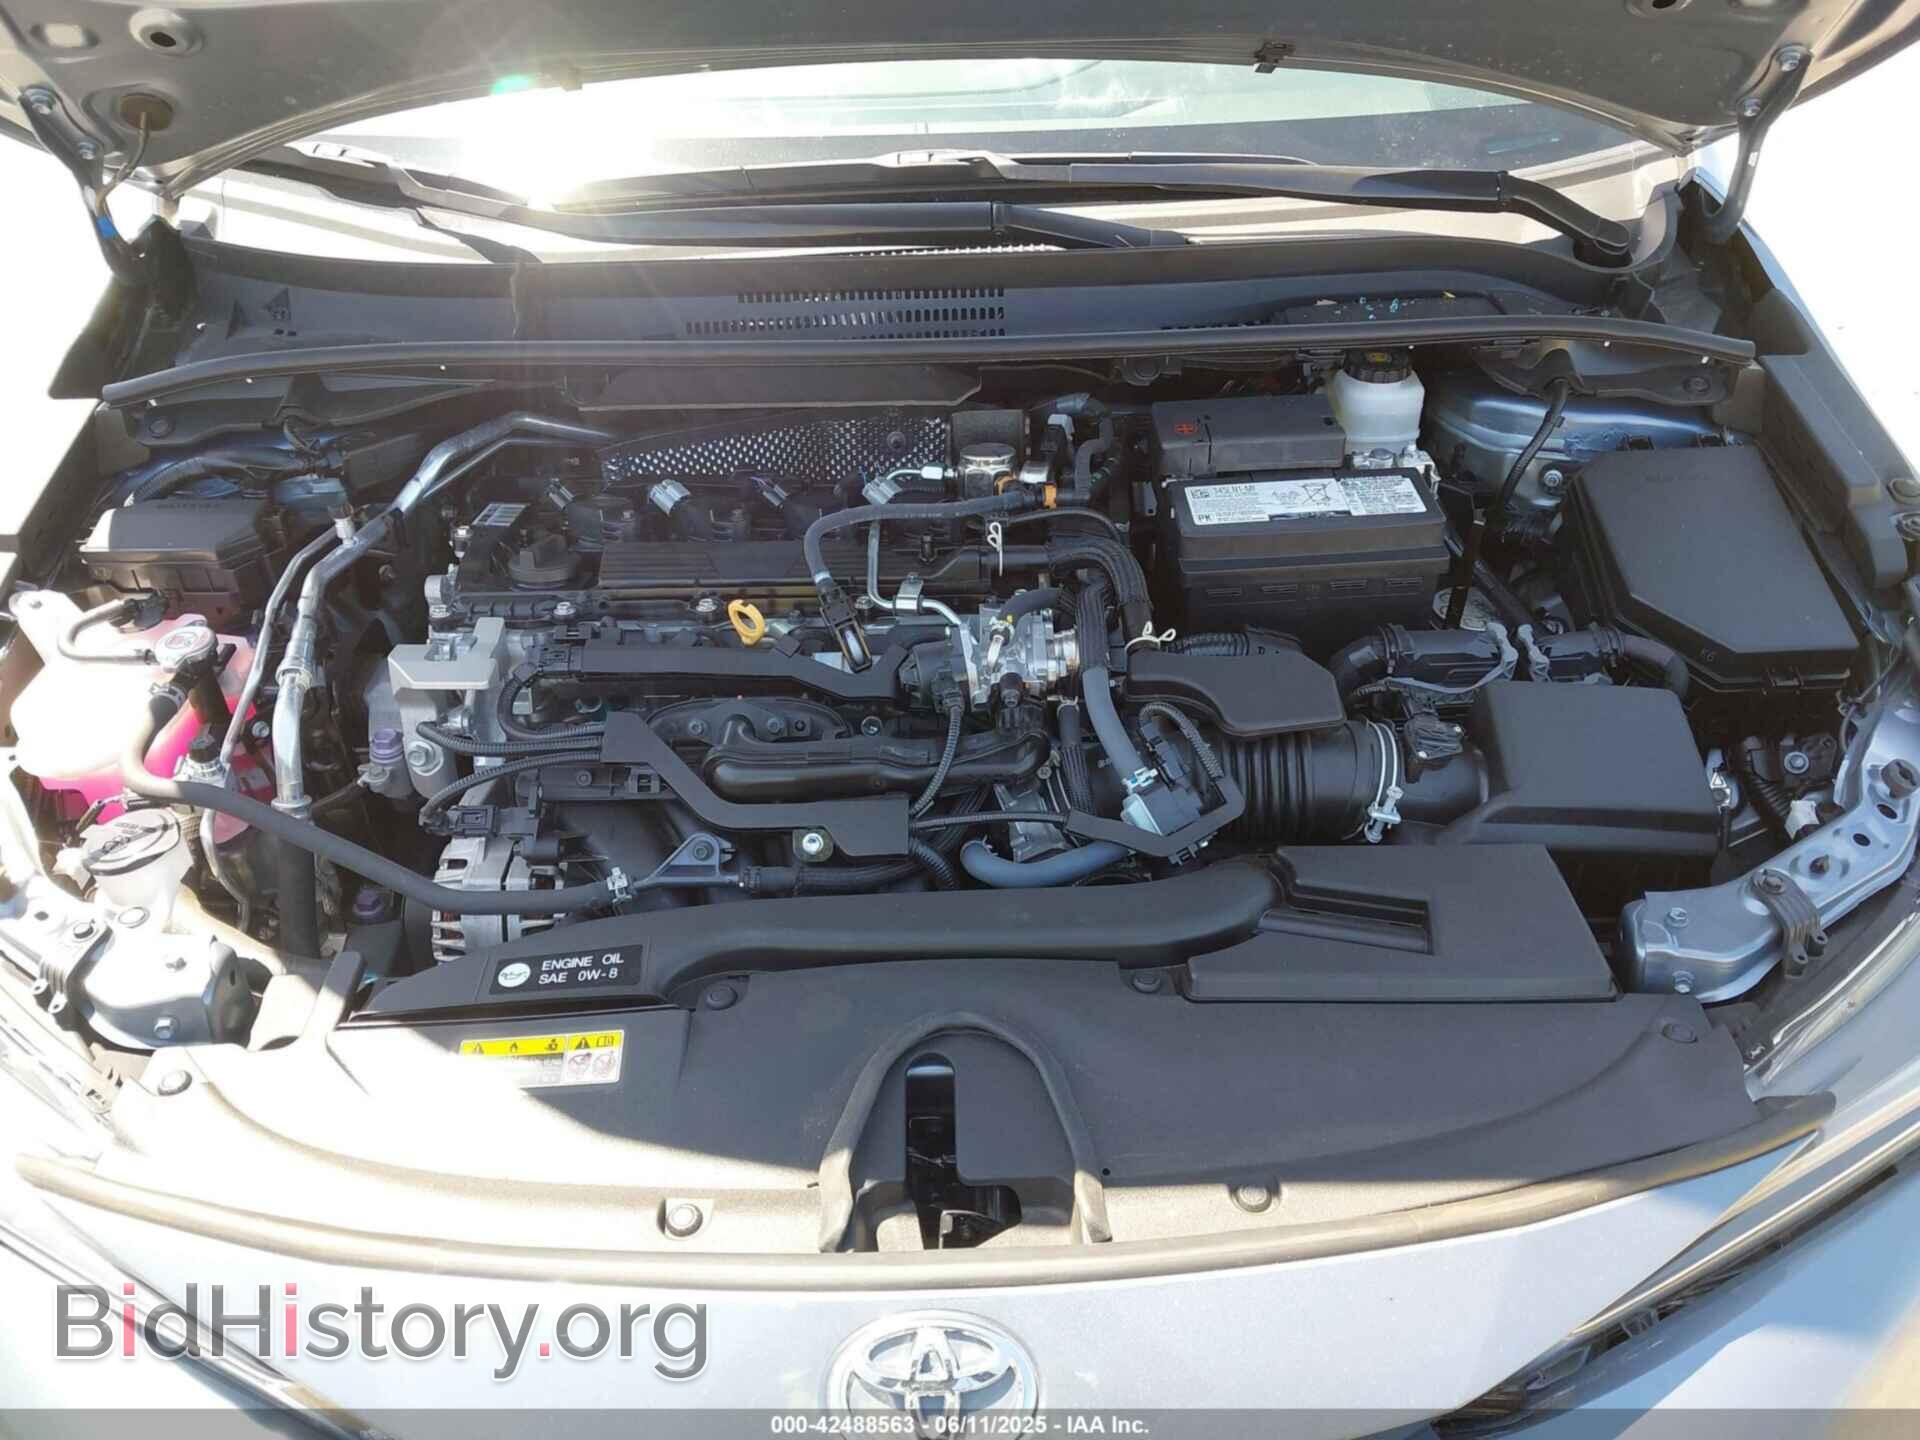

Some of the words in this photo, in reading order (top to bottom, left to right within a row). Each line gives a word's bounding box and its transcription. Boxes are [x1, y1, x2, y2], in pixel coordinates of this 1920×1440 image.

[541, 955, 594, 971] ENGINE
[602, 953, 624, 964] OIL
[538, 971, 568, 984] SAE
